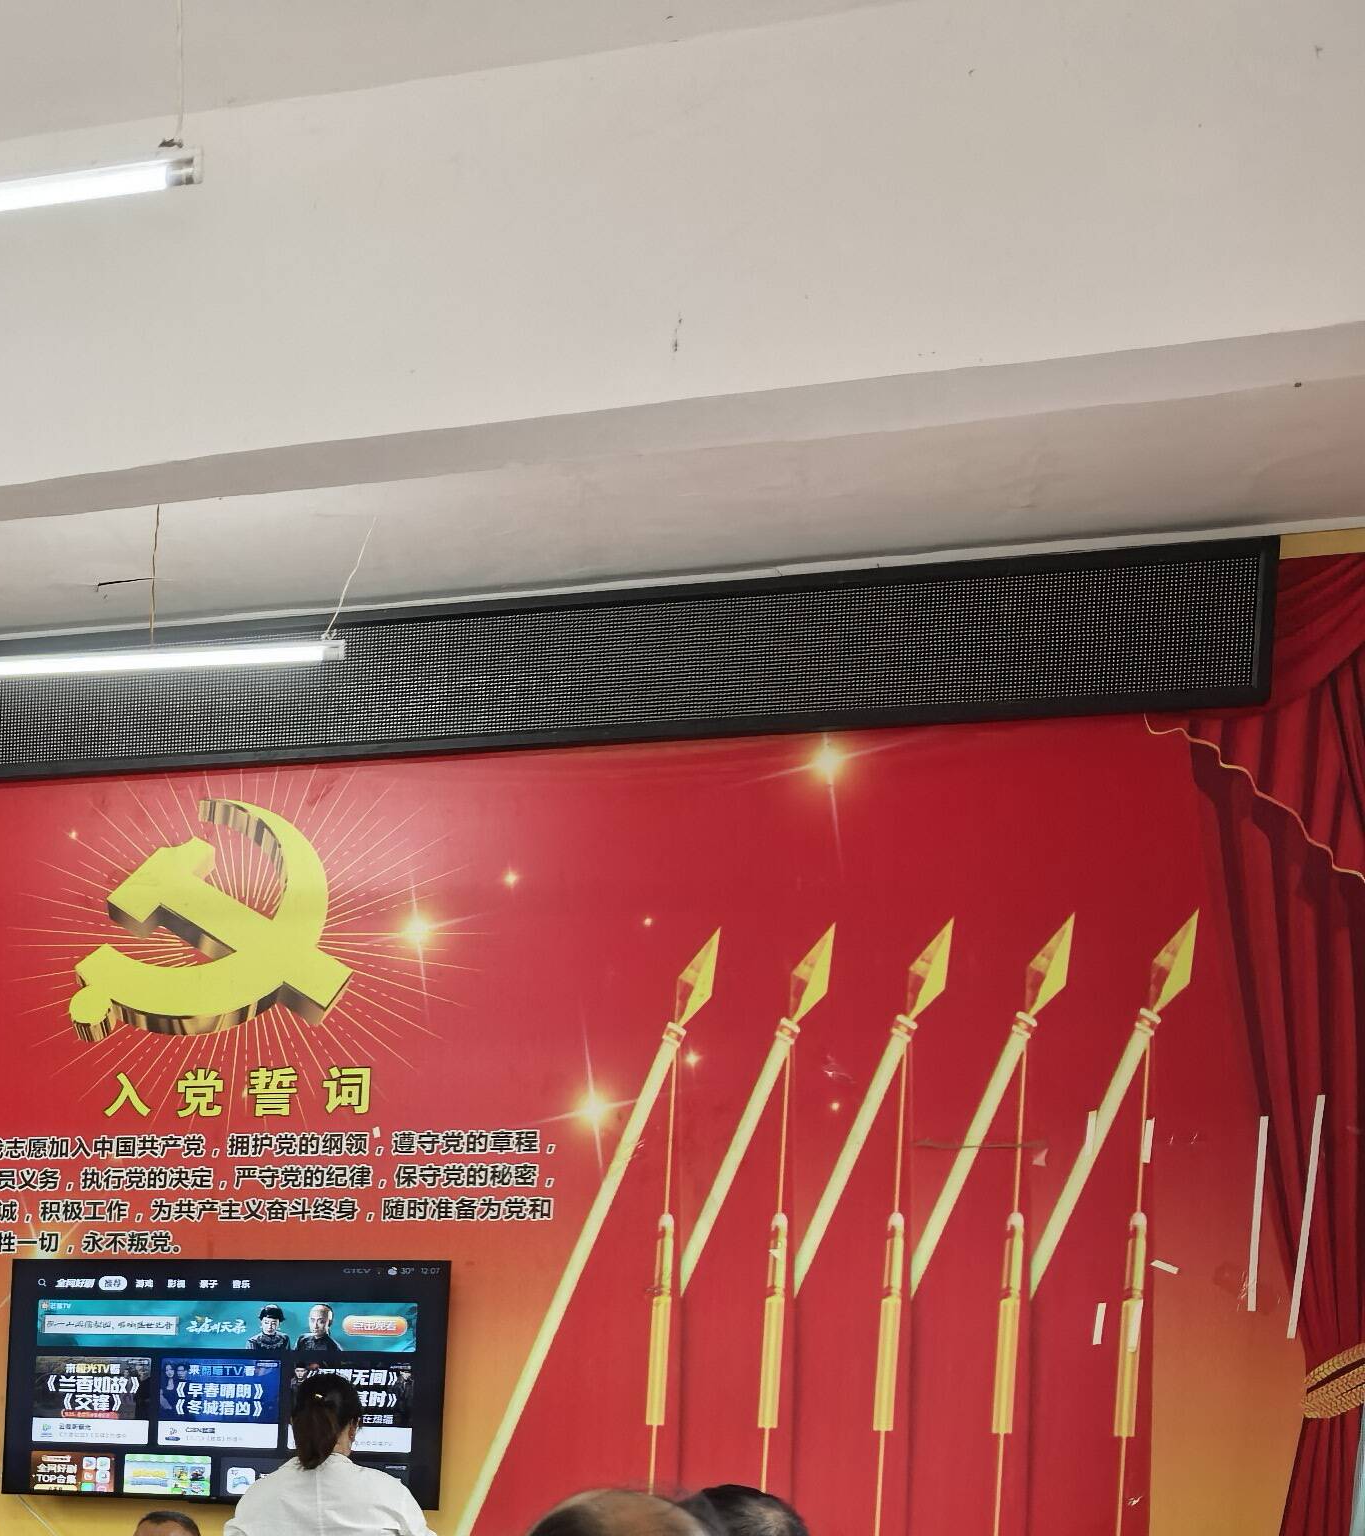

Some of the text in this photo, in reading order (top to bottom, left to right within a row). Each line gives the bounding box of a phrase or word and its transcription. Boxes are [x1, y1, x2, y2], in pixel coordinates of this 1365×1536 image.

[103, 1066, 373, 1117] 入党誓词
[47, 1374, 140, 1394] 《兰香如故》
[176, 1381, 264, 1400] 《早春晴朗》
[64, 1392, 122, 1411] 《交锋》
[175, 1398, 263, 1417] 《冬城猎凶》
